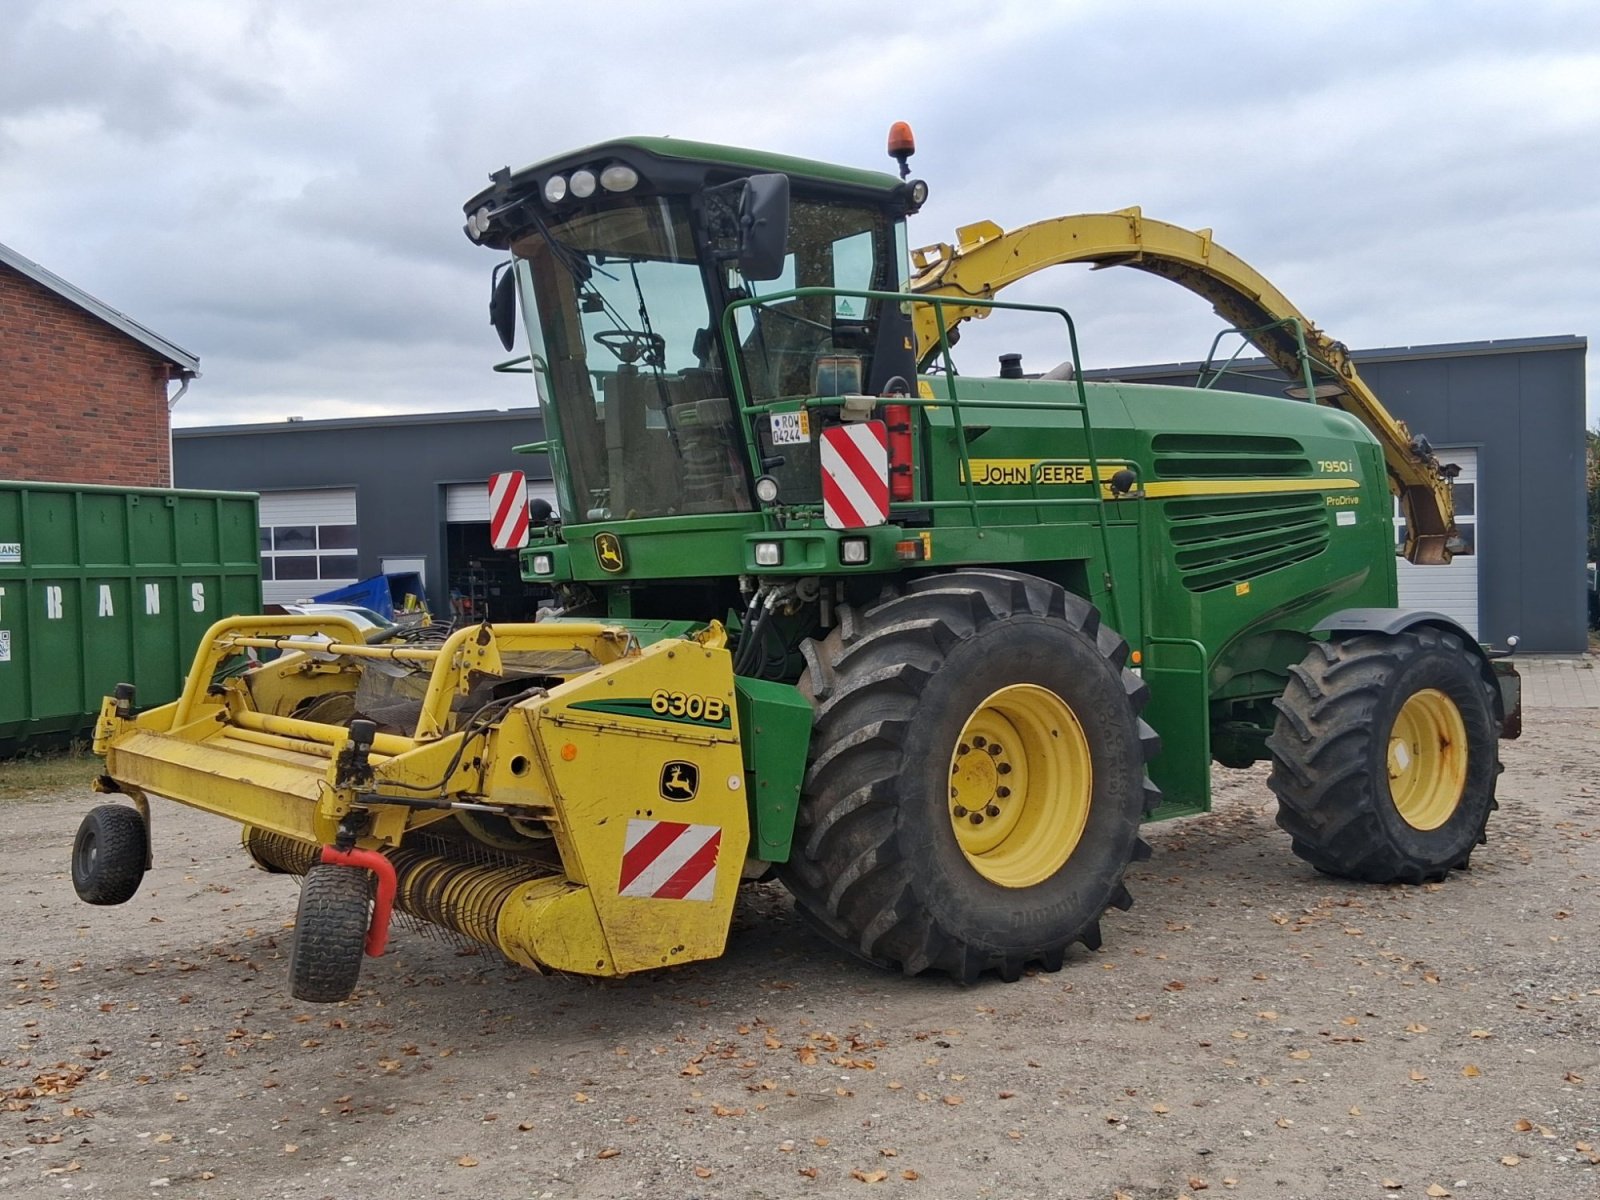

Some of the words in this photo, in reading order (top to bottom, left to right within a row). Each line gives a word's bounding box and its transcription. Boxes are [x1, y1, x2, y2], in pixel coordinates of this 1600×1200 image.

[980, 464, 1027, 482] JOHN
[1326, 495, 1359, 506] ProDrive
[0, 545, 20, 554] ANS
[651, 689, 724, 722] 630B
